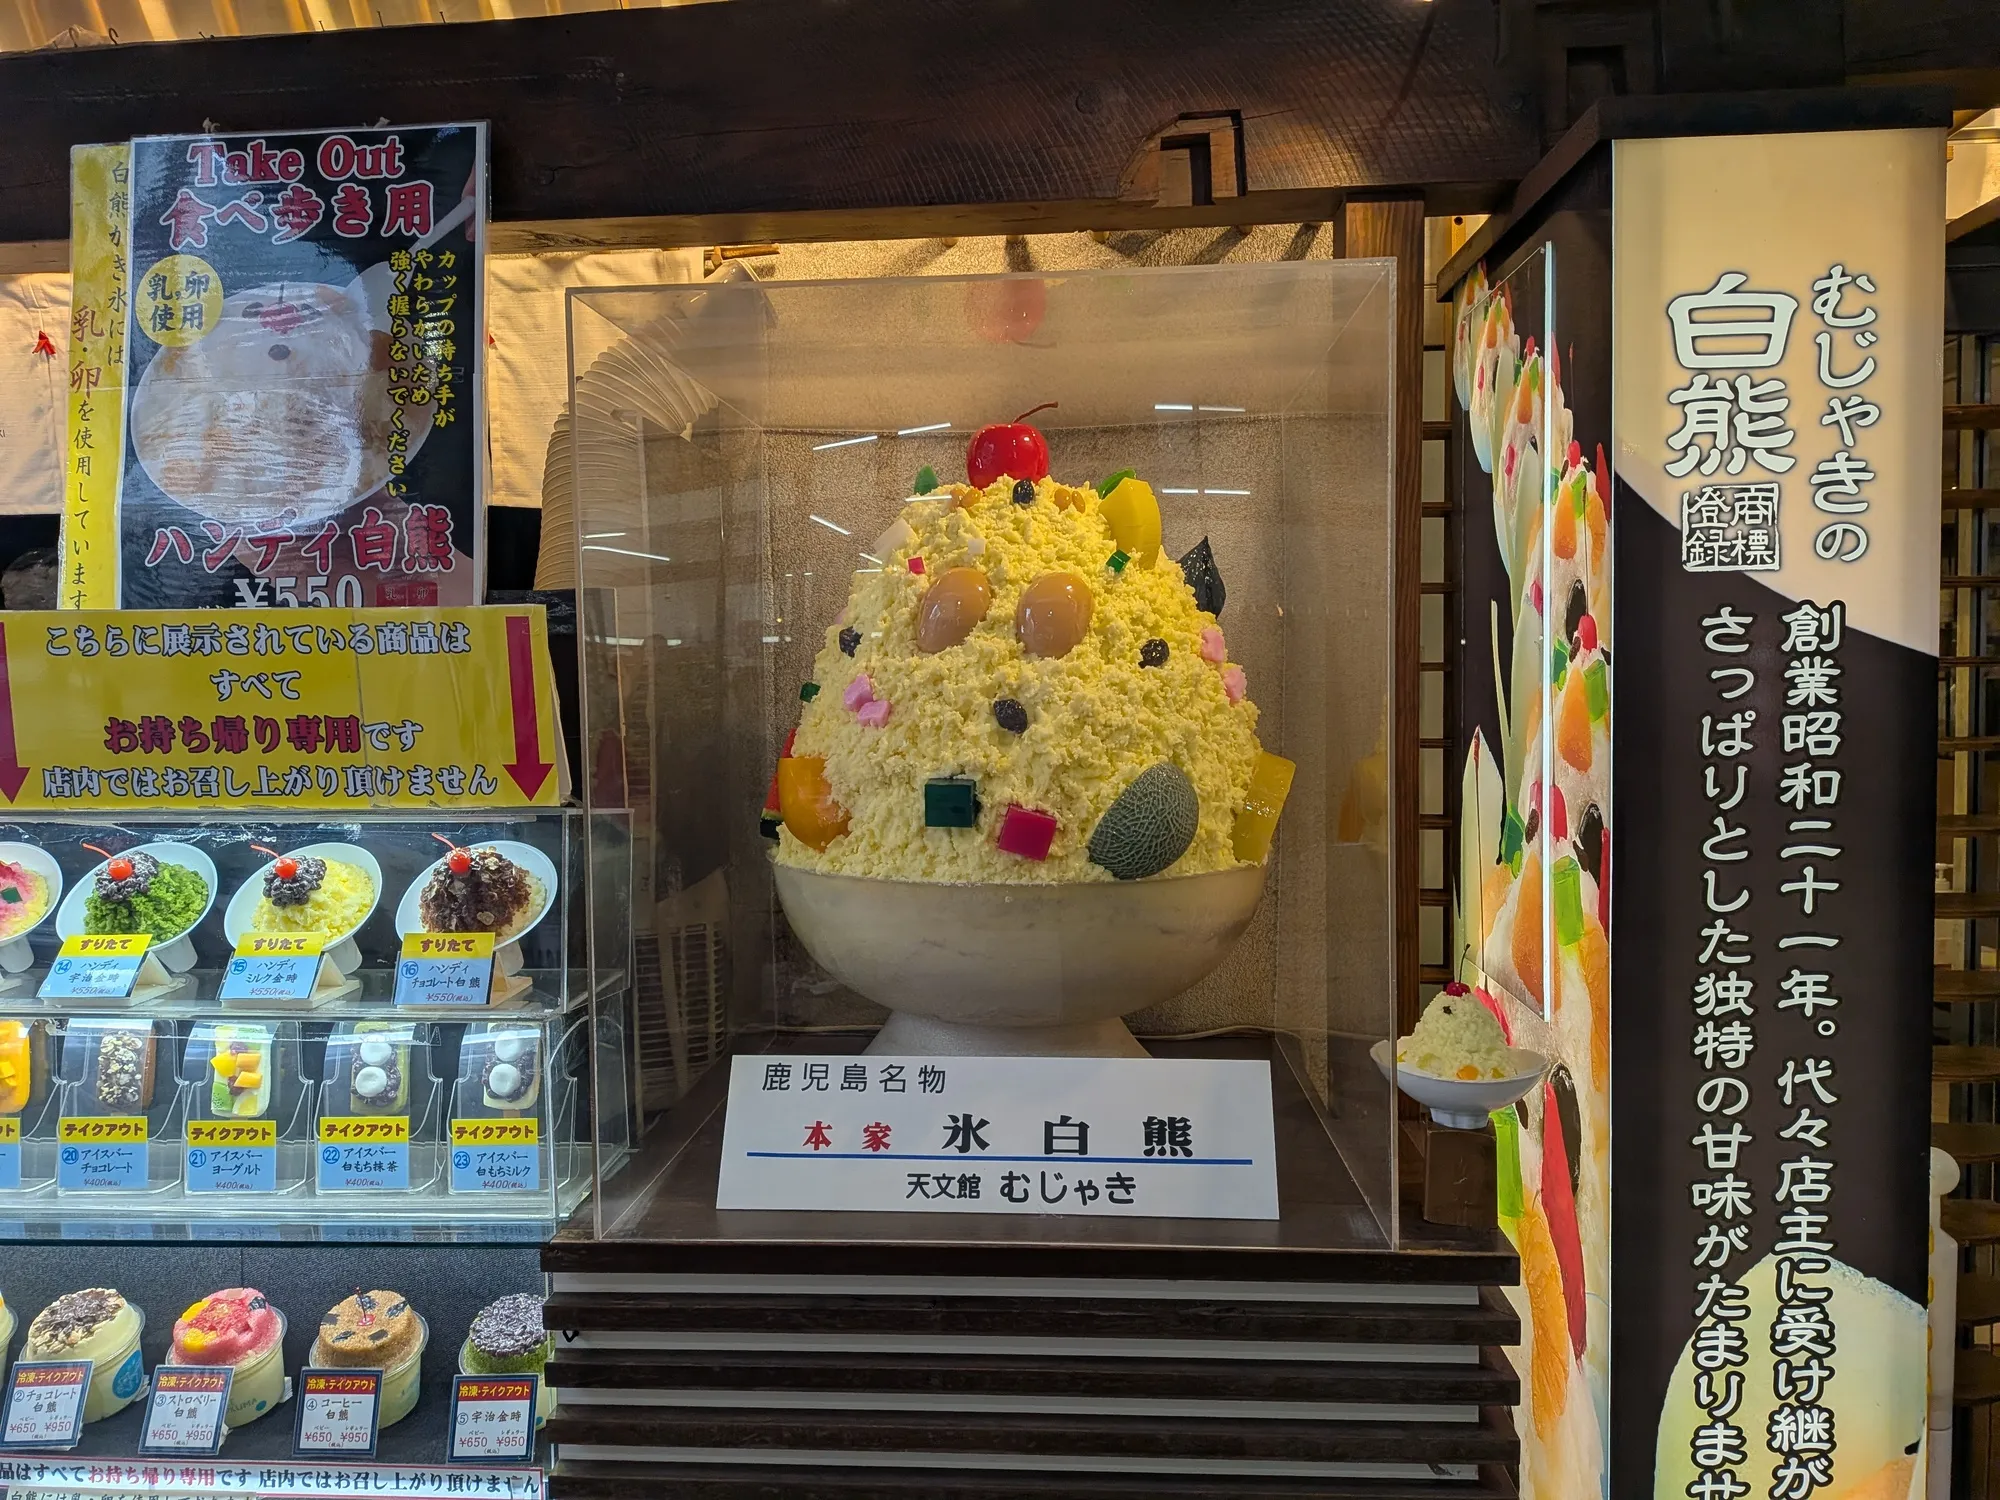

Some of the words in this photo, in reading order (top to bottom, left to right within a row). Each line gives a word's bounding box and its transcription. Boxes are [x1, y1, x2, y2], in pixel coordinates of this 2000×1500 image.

[187, 138, 305, 186] Take
[317, 135, 405, 180] Out
[160, 180, 435, 250] 食べ歩き用
[150, 304, 204, 332] 使用
[387, 250, 412, 498] 強く握らないでください
[1664, 272, 1799, 477] 白熊
[1810, 264, 1881, 561] むじゃきの
[144, 503, 455, 576] ハンディ白熊
[45, 623, 471, 658] こちらに展示されている商品は
[210, 670, 302, 701] すべて
[104, 715, 424, 755] お持ち帰り専用です
[43, 765, 498, 798] 店内ではお召し上がり頂けません
[80, 938, 132, 951] すりたて
[253, 937, 307, 951] すりたて
[420, 938, 476, 953] すりたて
[80, 959, 119, 970] ハンディ
[256, 960, 296, 971] ハンディ
[428, 961, 468, 975] ハンディ
[245, 972, 297, 984] ミルク金時
[761, 1062, 947, 1095] 鹿児島名物
[64, 1123, 144, 1137] テイクアウト
[191, 1127, 272, 1141] テイクアウト
[325, 1123, 405, 1138] テイクアウト
[455, 1125, 534, 1140] テイクアウト
[802, 1120, 892, 1152] 本家
[81, 1148, 133, 1162] アイスバー
[210, 1151, 263, 1162] アイスバー
[343, 1147, 396, 1158] アイスバー
[476, 1152, 529, 1163] アイスバー
[80, 1162, 133, 1174] チョコレート
[212, 1163, 261, 1175] ヨーグルト
[341, 1160, 399, 1173] 白もち抹茶
[475, 1164, 532, 1178] 白もちミルク
[906, 1172, 982, 1200] 天文館
[999, 1170, 1137, 1206] むじゃき
[27, 1388, 77, 1400] チョコレート
[167, 1394, 216, 1406] ストロベリー
[33, 1401, 57, 1413] 白熊
[321, 1398, 362, 1408] コーヒー
[174, 1407, 198, 1419] 白熊
[326, 1409, 349, 1421] 白熊
[471, 1410, 522, 1423] 宇治金時
[9, 1423, 36, 1433] ¥650
[44, 1421, 71, 1432] ¥950
[151, 1429, 178, 1441] ¥650
[186, 1430, 213, 1441] ¥950
[304, 1431, 332, 1443] ¥650
[340, 1431, 368, 1443] ¥950
[459, 1436, 488, 1448] ¥650
[496, 1436, 525, 1447] ¥950
